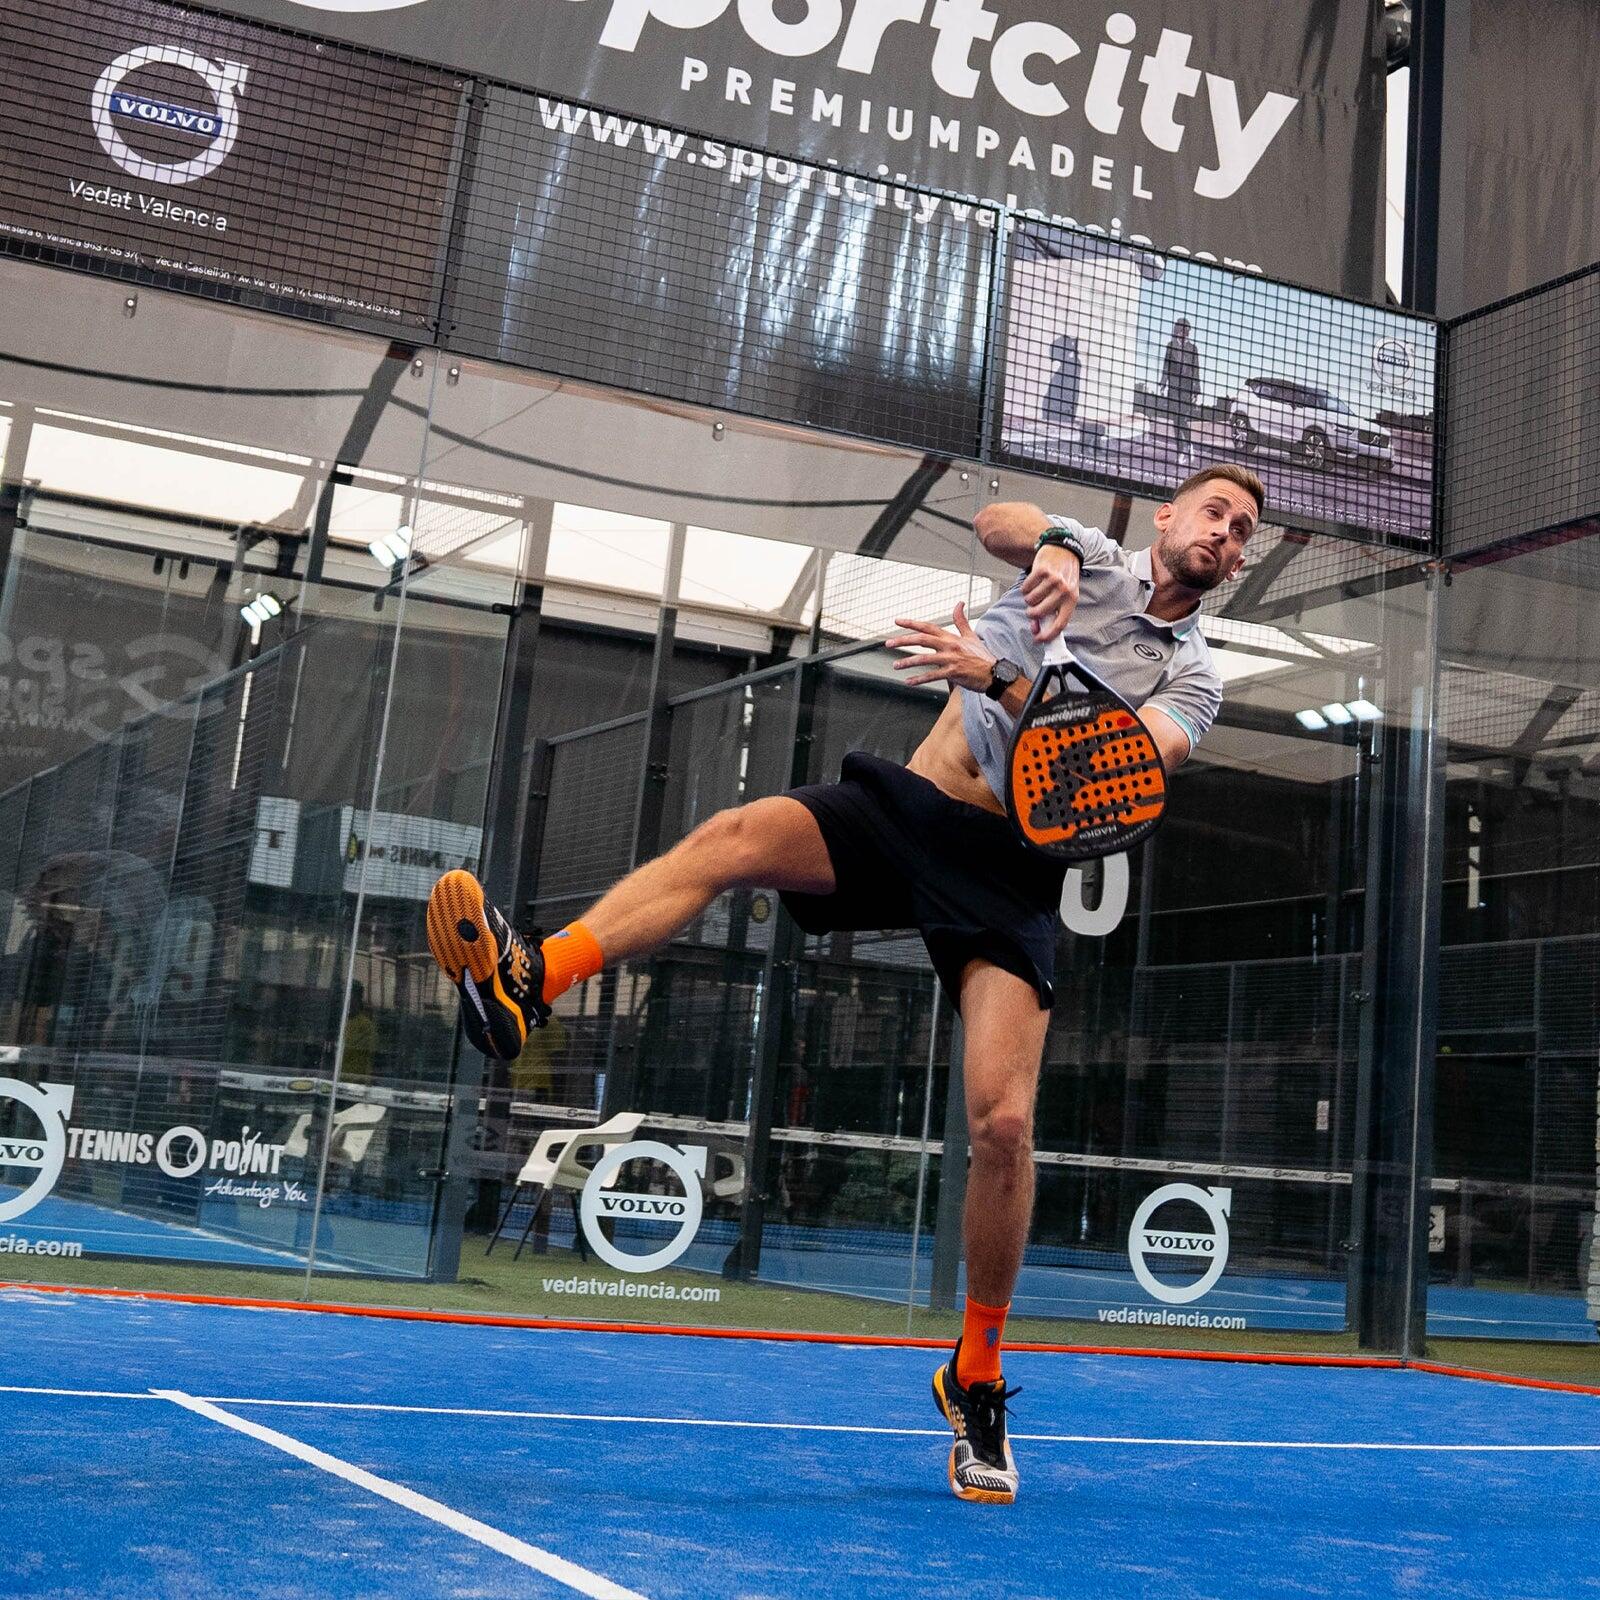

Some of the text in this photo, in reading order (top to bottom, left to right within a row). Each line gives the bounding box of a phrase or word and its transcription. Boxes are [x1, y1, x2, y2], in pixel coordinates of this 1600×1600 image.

[117, 98, 216, 133] VOLVO
[680, 56, 1153, 200] PREMIUMPADEL
[69, 177, 228, 231] Vedat Valencia
[0, 1145, 43, 1161] VO
[67, 1127, 154, 1164] TENNIS
[205, 1178, 308, 1208] Advantage You
[599, 1197, 686, 1216] VOLVO
[1143, 1234, 1215, 1252] VOLVO
[542, 1276, 721, 1302] vedatvalencia.com
[1098, 1307, 1246, 1330] vedatvalencia.com
